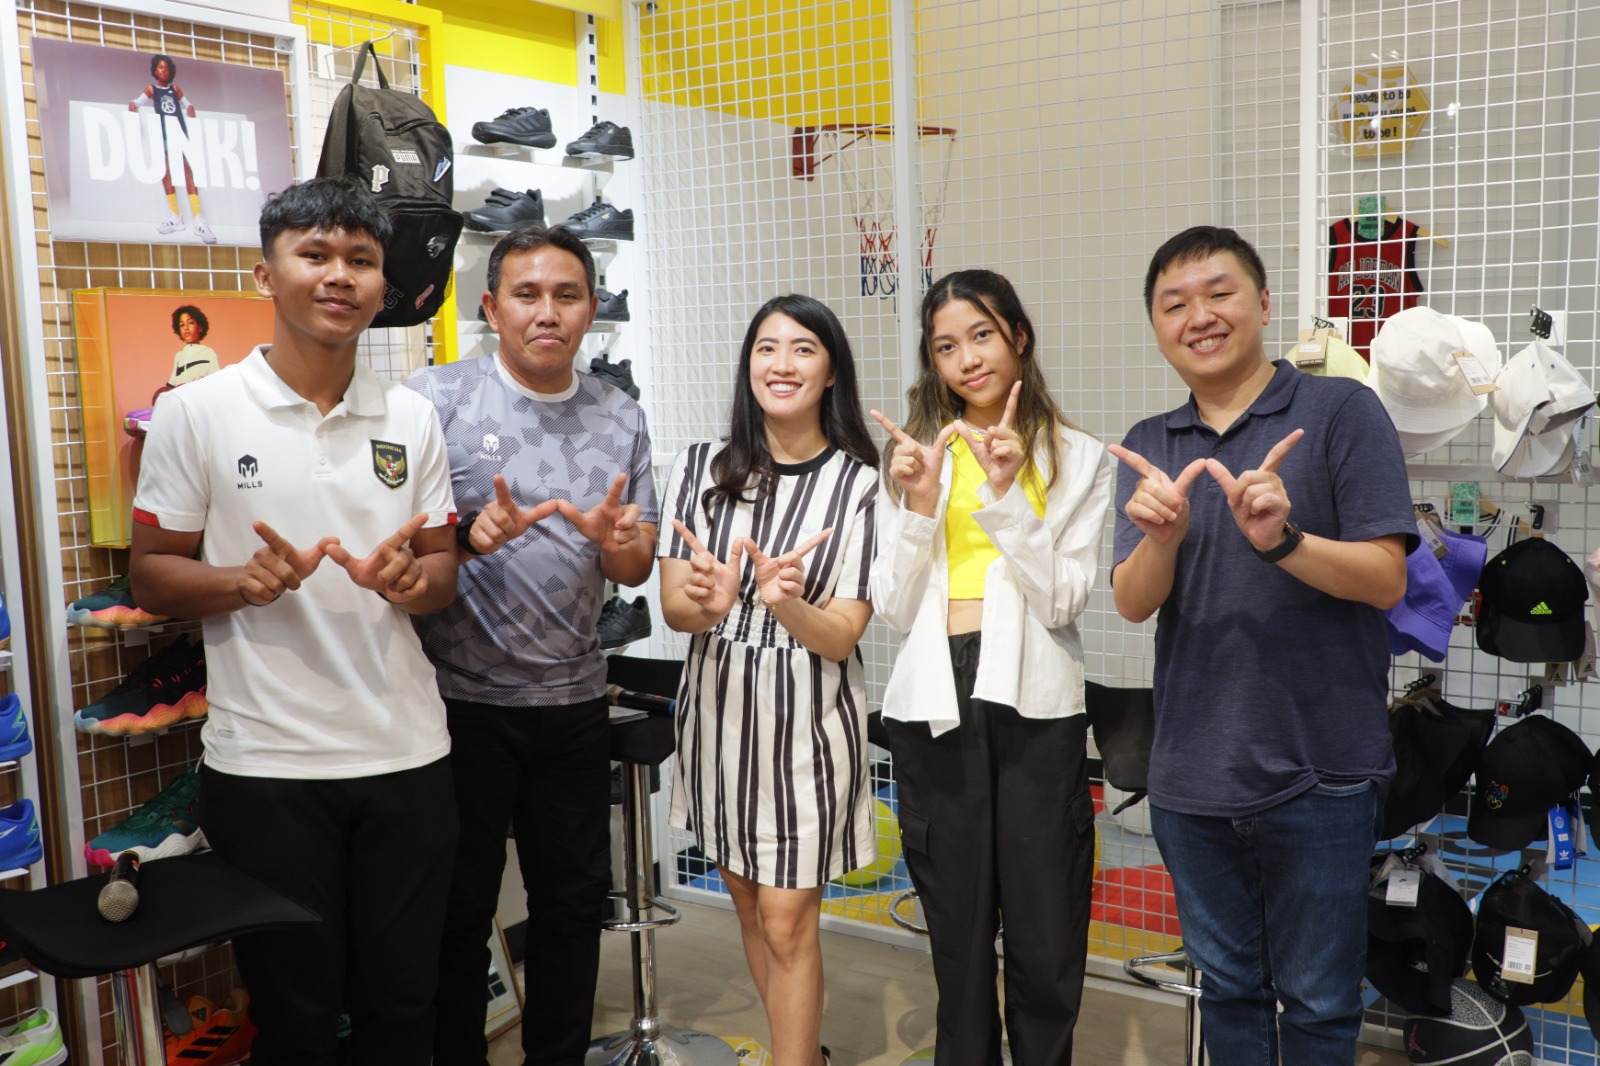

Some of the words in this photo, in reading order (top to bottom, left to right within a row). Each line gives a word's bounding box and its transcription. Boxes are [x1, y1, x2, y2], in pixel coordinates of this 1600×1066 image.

[1383, 91, 1396, 101] to
[1398, 90, 1411, 100] be
[1363, 129, 1375, 139] to
[82, 106, 260, 191] DUNK!
[394, 153, 418, 162] PUMA
[1356, 257, 1400, 292] JORDAN
[1350, 284, 1386, 319] 23
[237, 480, 263, 490] MILLS
